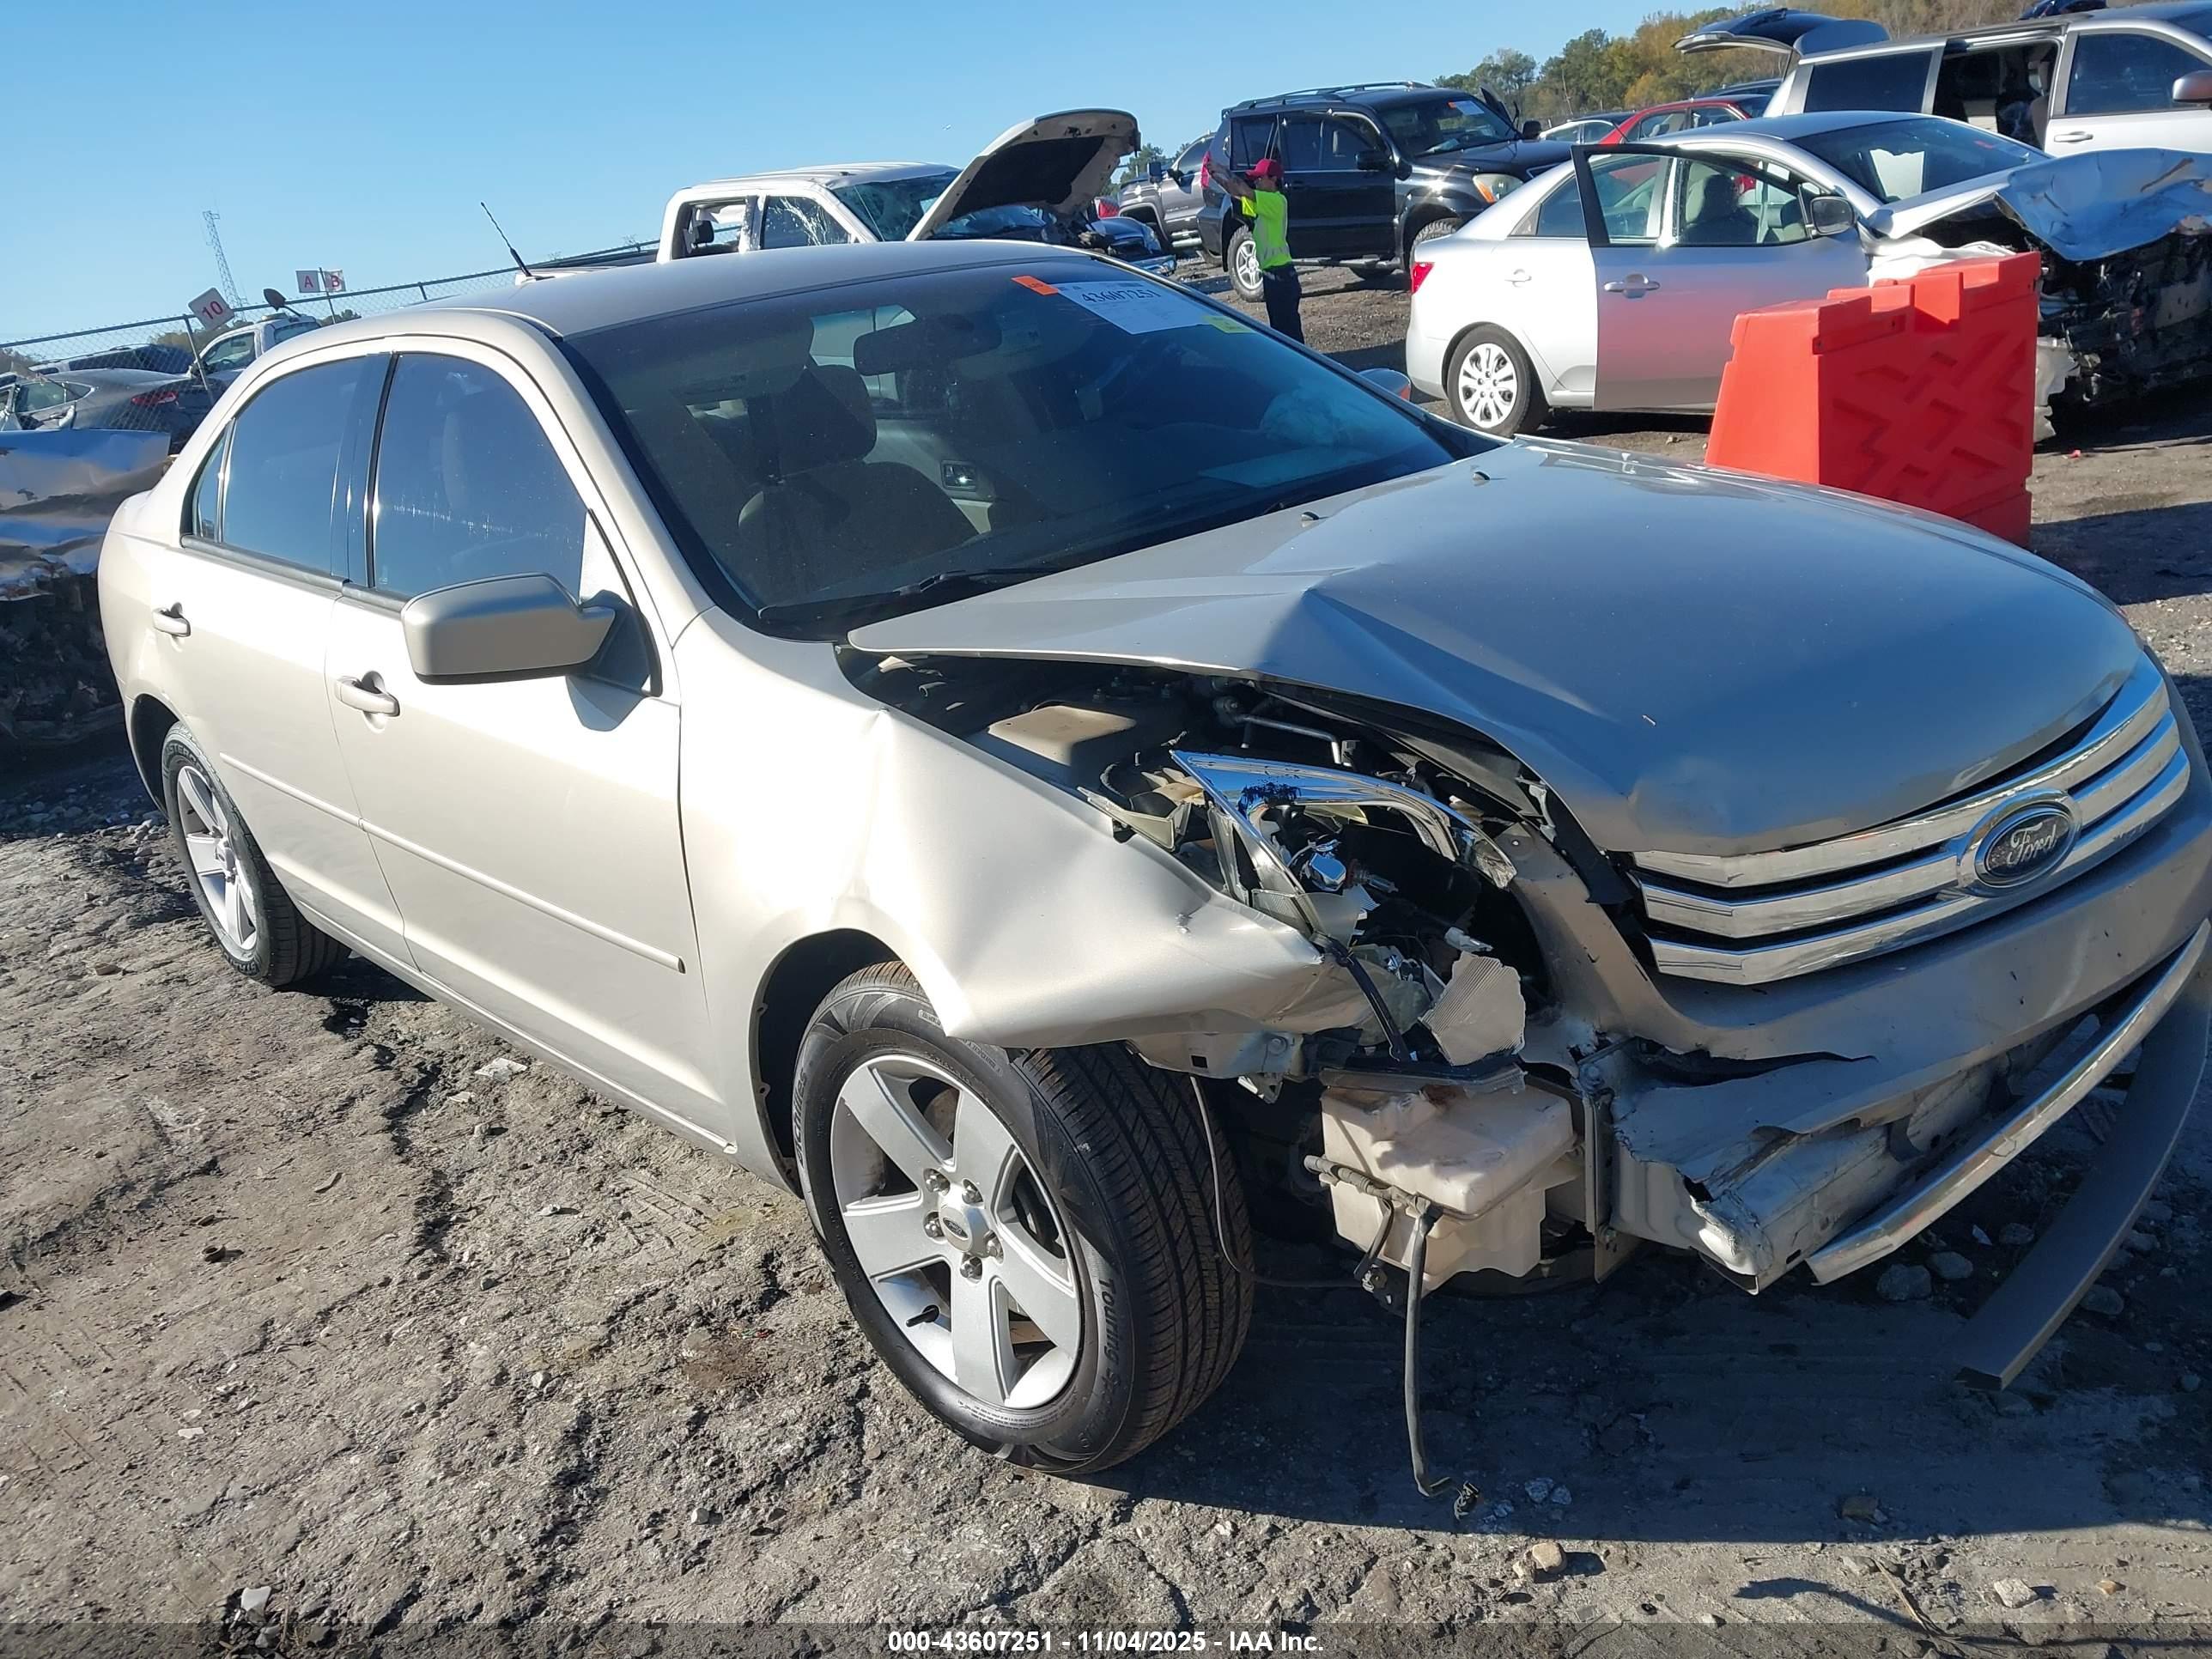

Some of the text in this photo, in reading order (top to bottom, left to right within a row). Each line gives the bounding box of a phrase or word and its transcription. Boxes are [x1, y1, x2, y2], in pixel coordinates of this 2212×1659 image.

[304, 275, 314, 289] A
[331, 274, 341, 288] B
[1081, 289, 1161, 303] 43607251
[202, 301, 224, 320] 10
[2007, 822, 2057, 866] Ford
[1098, 1277, 1121, 1365] Touring
